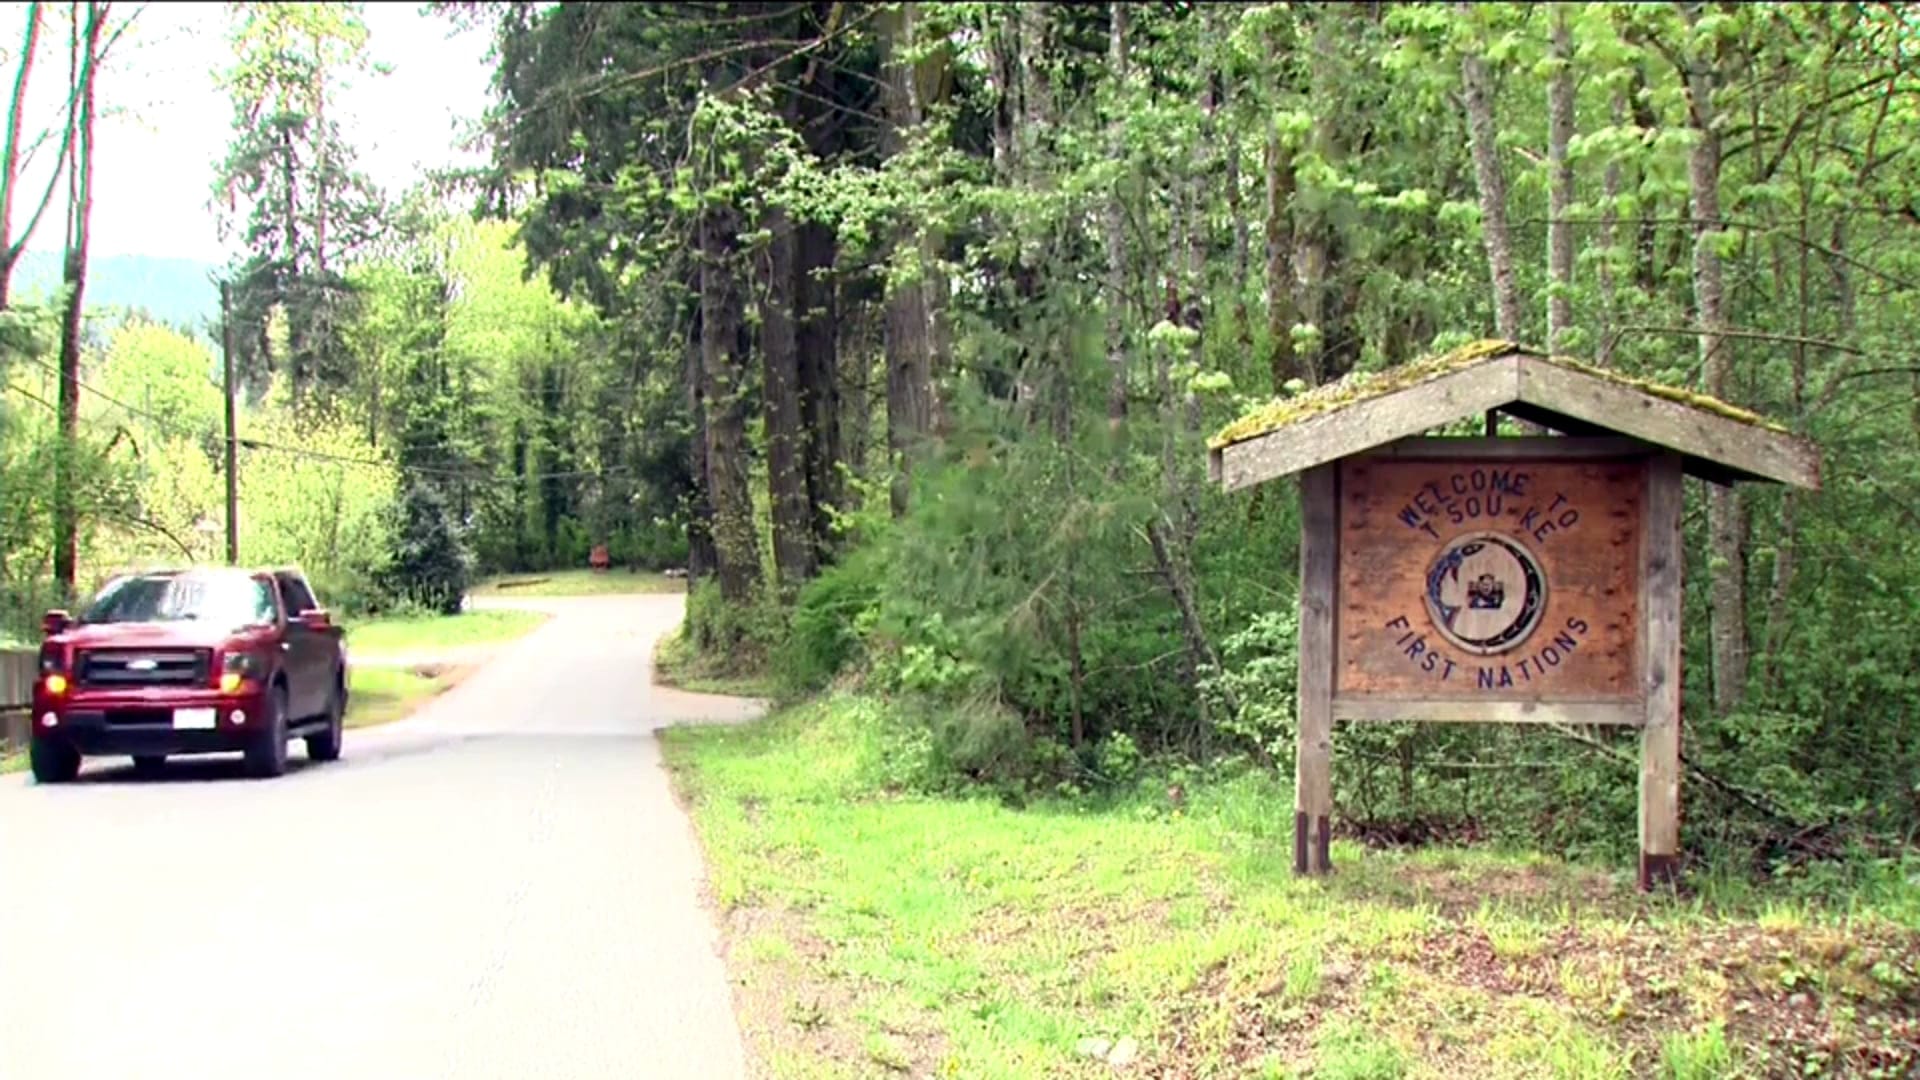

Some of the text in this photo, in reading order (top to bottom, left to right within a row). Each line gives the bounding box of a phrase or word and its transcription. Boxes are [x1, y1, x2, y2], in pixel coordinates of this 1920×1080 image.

[1397, 469, 1580, 529] WELCOME TO
[1386, 615, 1589, 689] FIRST NATIONS
